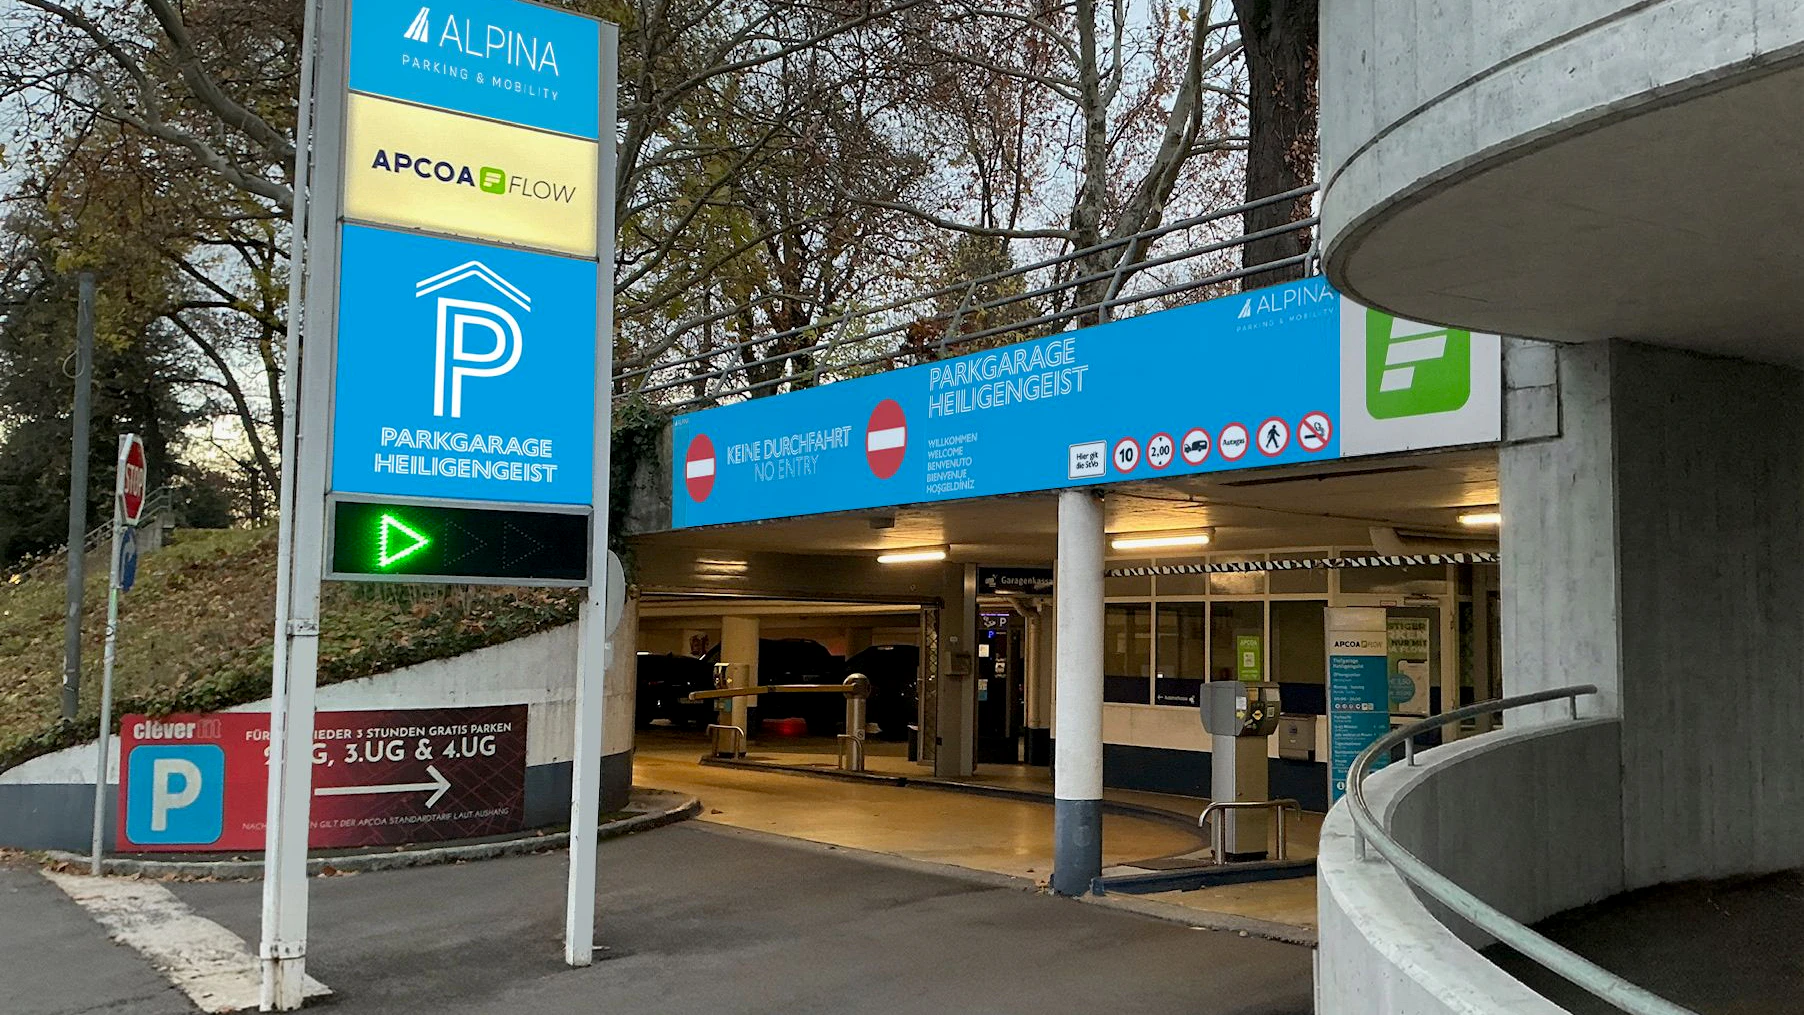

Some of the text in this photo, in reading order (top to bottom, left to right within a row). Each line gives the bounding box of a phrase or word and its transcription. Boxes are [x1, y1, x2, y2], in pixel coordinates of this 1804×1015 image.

[439, 14, 560, 77] ALPINA
[402, 54, 559, 101] PARKING & MOBILITY
[371, 149, 576, 204] APCOA FLOW
[1256, 283, 1335, 315] ALPINA
[929, 337, 1076, 391] PARKGARAGE
[928, 364, 1089, 418] HEILIGENGEIST
[380, 427, 553, 458] PARKGARAGE
[727, 425, 852, 465] KEINE DURCHFAHRT
[927, 446, 964, 459] WELCOME
[928, 432, 978, 448] WILLKOMMEN
[1151, 445, 1170, 457] 2,00
[374, 453, 558, 483] HEILIGENGEIST
[755, 454, 820, 482] NO ENTRY
[927, 456, 973, 471] BENVENUTO
[1075, 461, 1085, 470] die
[1076, 452, 1089, 461] Hier
[1119, 448, 1134, 462] 10
[125, 463, 144, 496] STOP
[926, 468, 967, 483] BIENVENUE
[133, 719, 196, 740] clever
[246, 729, 270, 741] FÜR
[357, 730, 363, 739] 3
[367, 726, 425, 739] STUNDEN
[428, 724, 468, 736] GRATIS
[470, 722, 512, 734] PARKEN
[344, 740, 406, 764] 3.UG
[414, 737, 433, 761] &
[443, 736, 497, 758] 4.UG
[151, 758, 203, 831] P
[357, 818, 386, 827] APCOA
[389, 812, 452, 826] STANDARDTARIF
[453, 810, 473, 820] LAUT
[474, 807, 509, 818] AUSHANG
